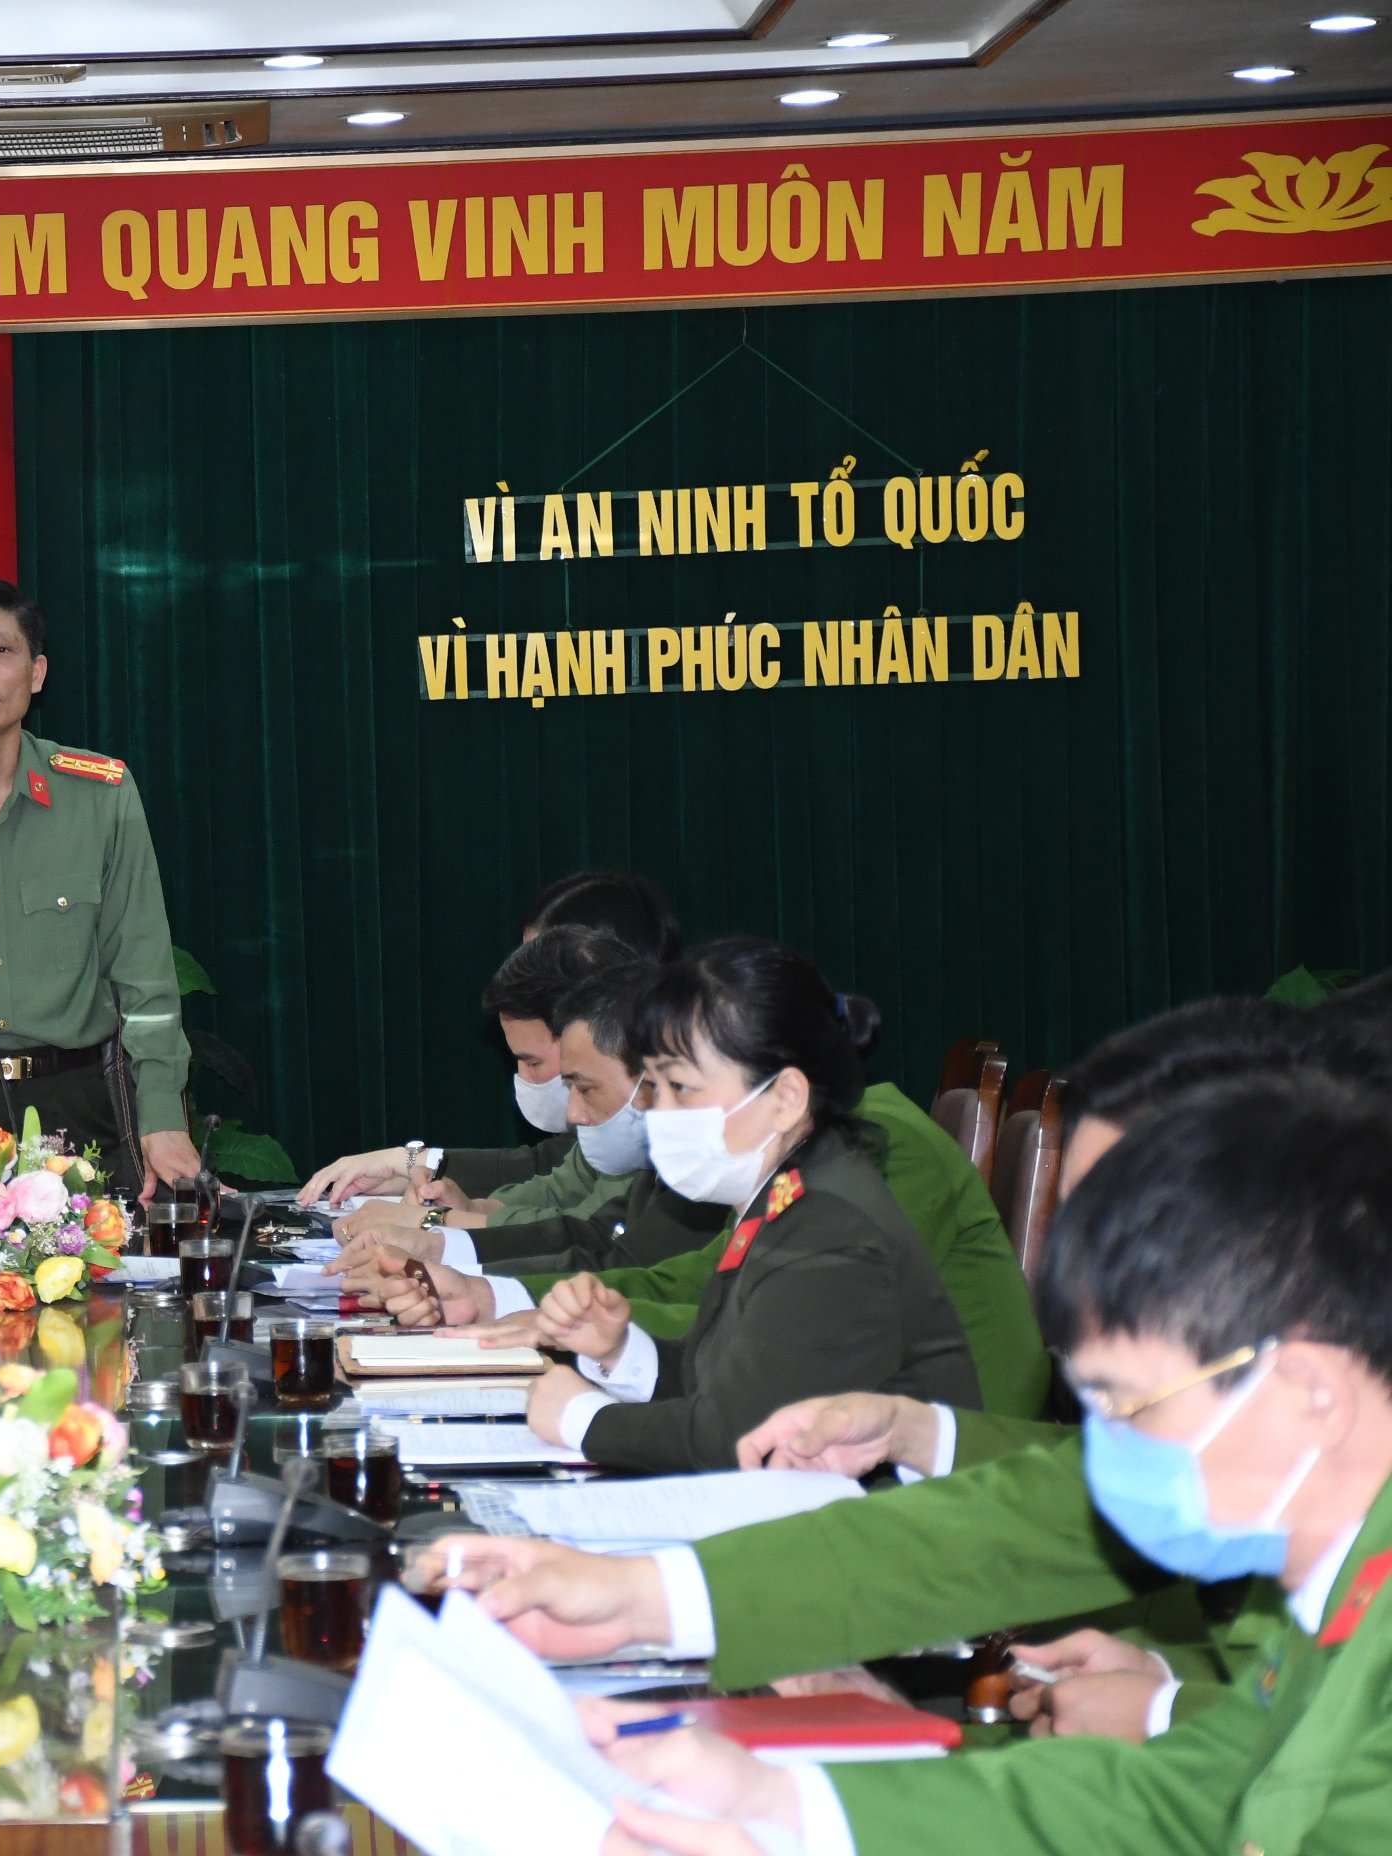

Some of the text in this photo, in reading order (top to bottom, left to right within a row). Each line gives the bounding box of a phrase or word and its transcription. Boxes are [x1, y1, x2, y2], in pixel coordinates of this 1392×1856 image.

[102, 200, 379, 300] QUANG
[409, 192, 603, 281] VINH
[644, 164, 884, 270] MUÔN
[924, 150, 1123, 257] NĂM
[464, 450, 1024, 563] VÌ AN NINH TỔ QUỐC
[419, 603, 1079, 708] VÌ HẠNH PHÚC NHÂN DÂN
